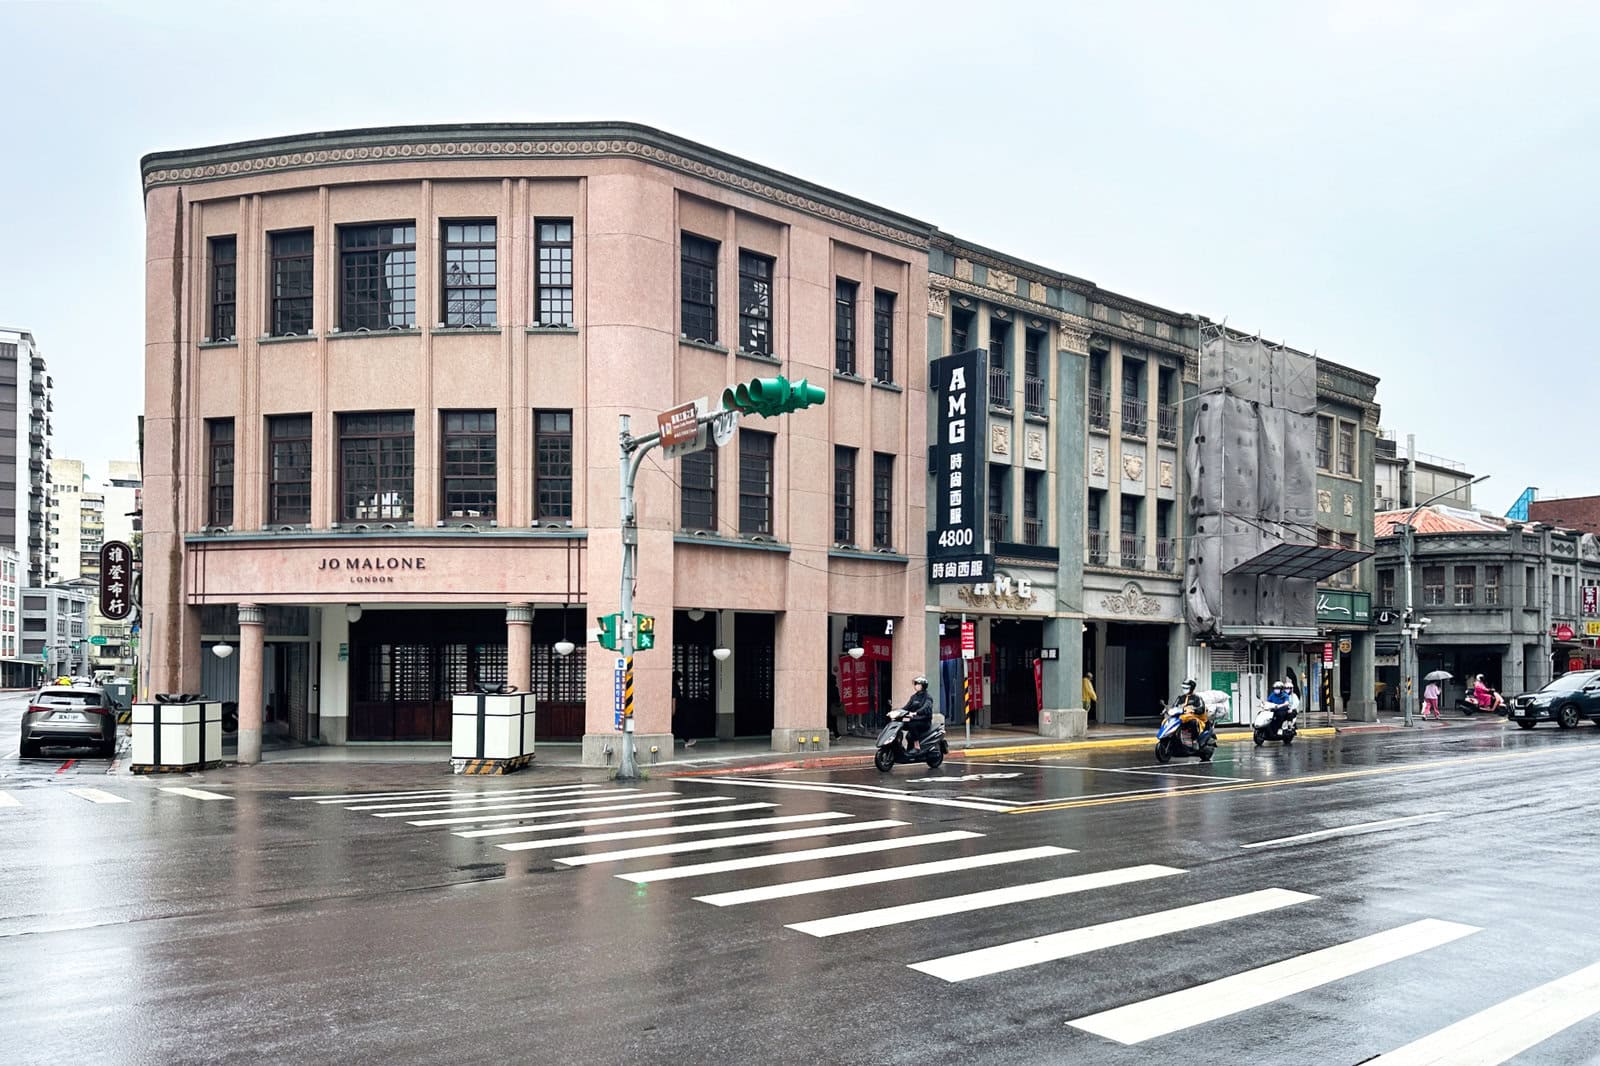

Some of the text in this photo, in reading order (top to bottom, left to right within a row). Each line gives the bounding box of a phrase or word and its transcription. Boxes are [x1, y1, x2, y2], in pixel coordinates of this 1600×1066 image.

[948, 366, 967, 444] AMG
[949, 453, 962, 524] 時尚西服
[938, 528, 973, 548] 4800
[318, 557, 426, 570] JO MALONE
[932, 560, 983, 579] 時尚西服
